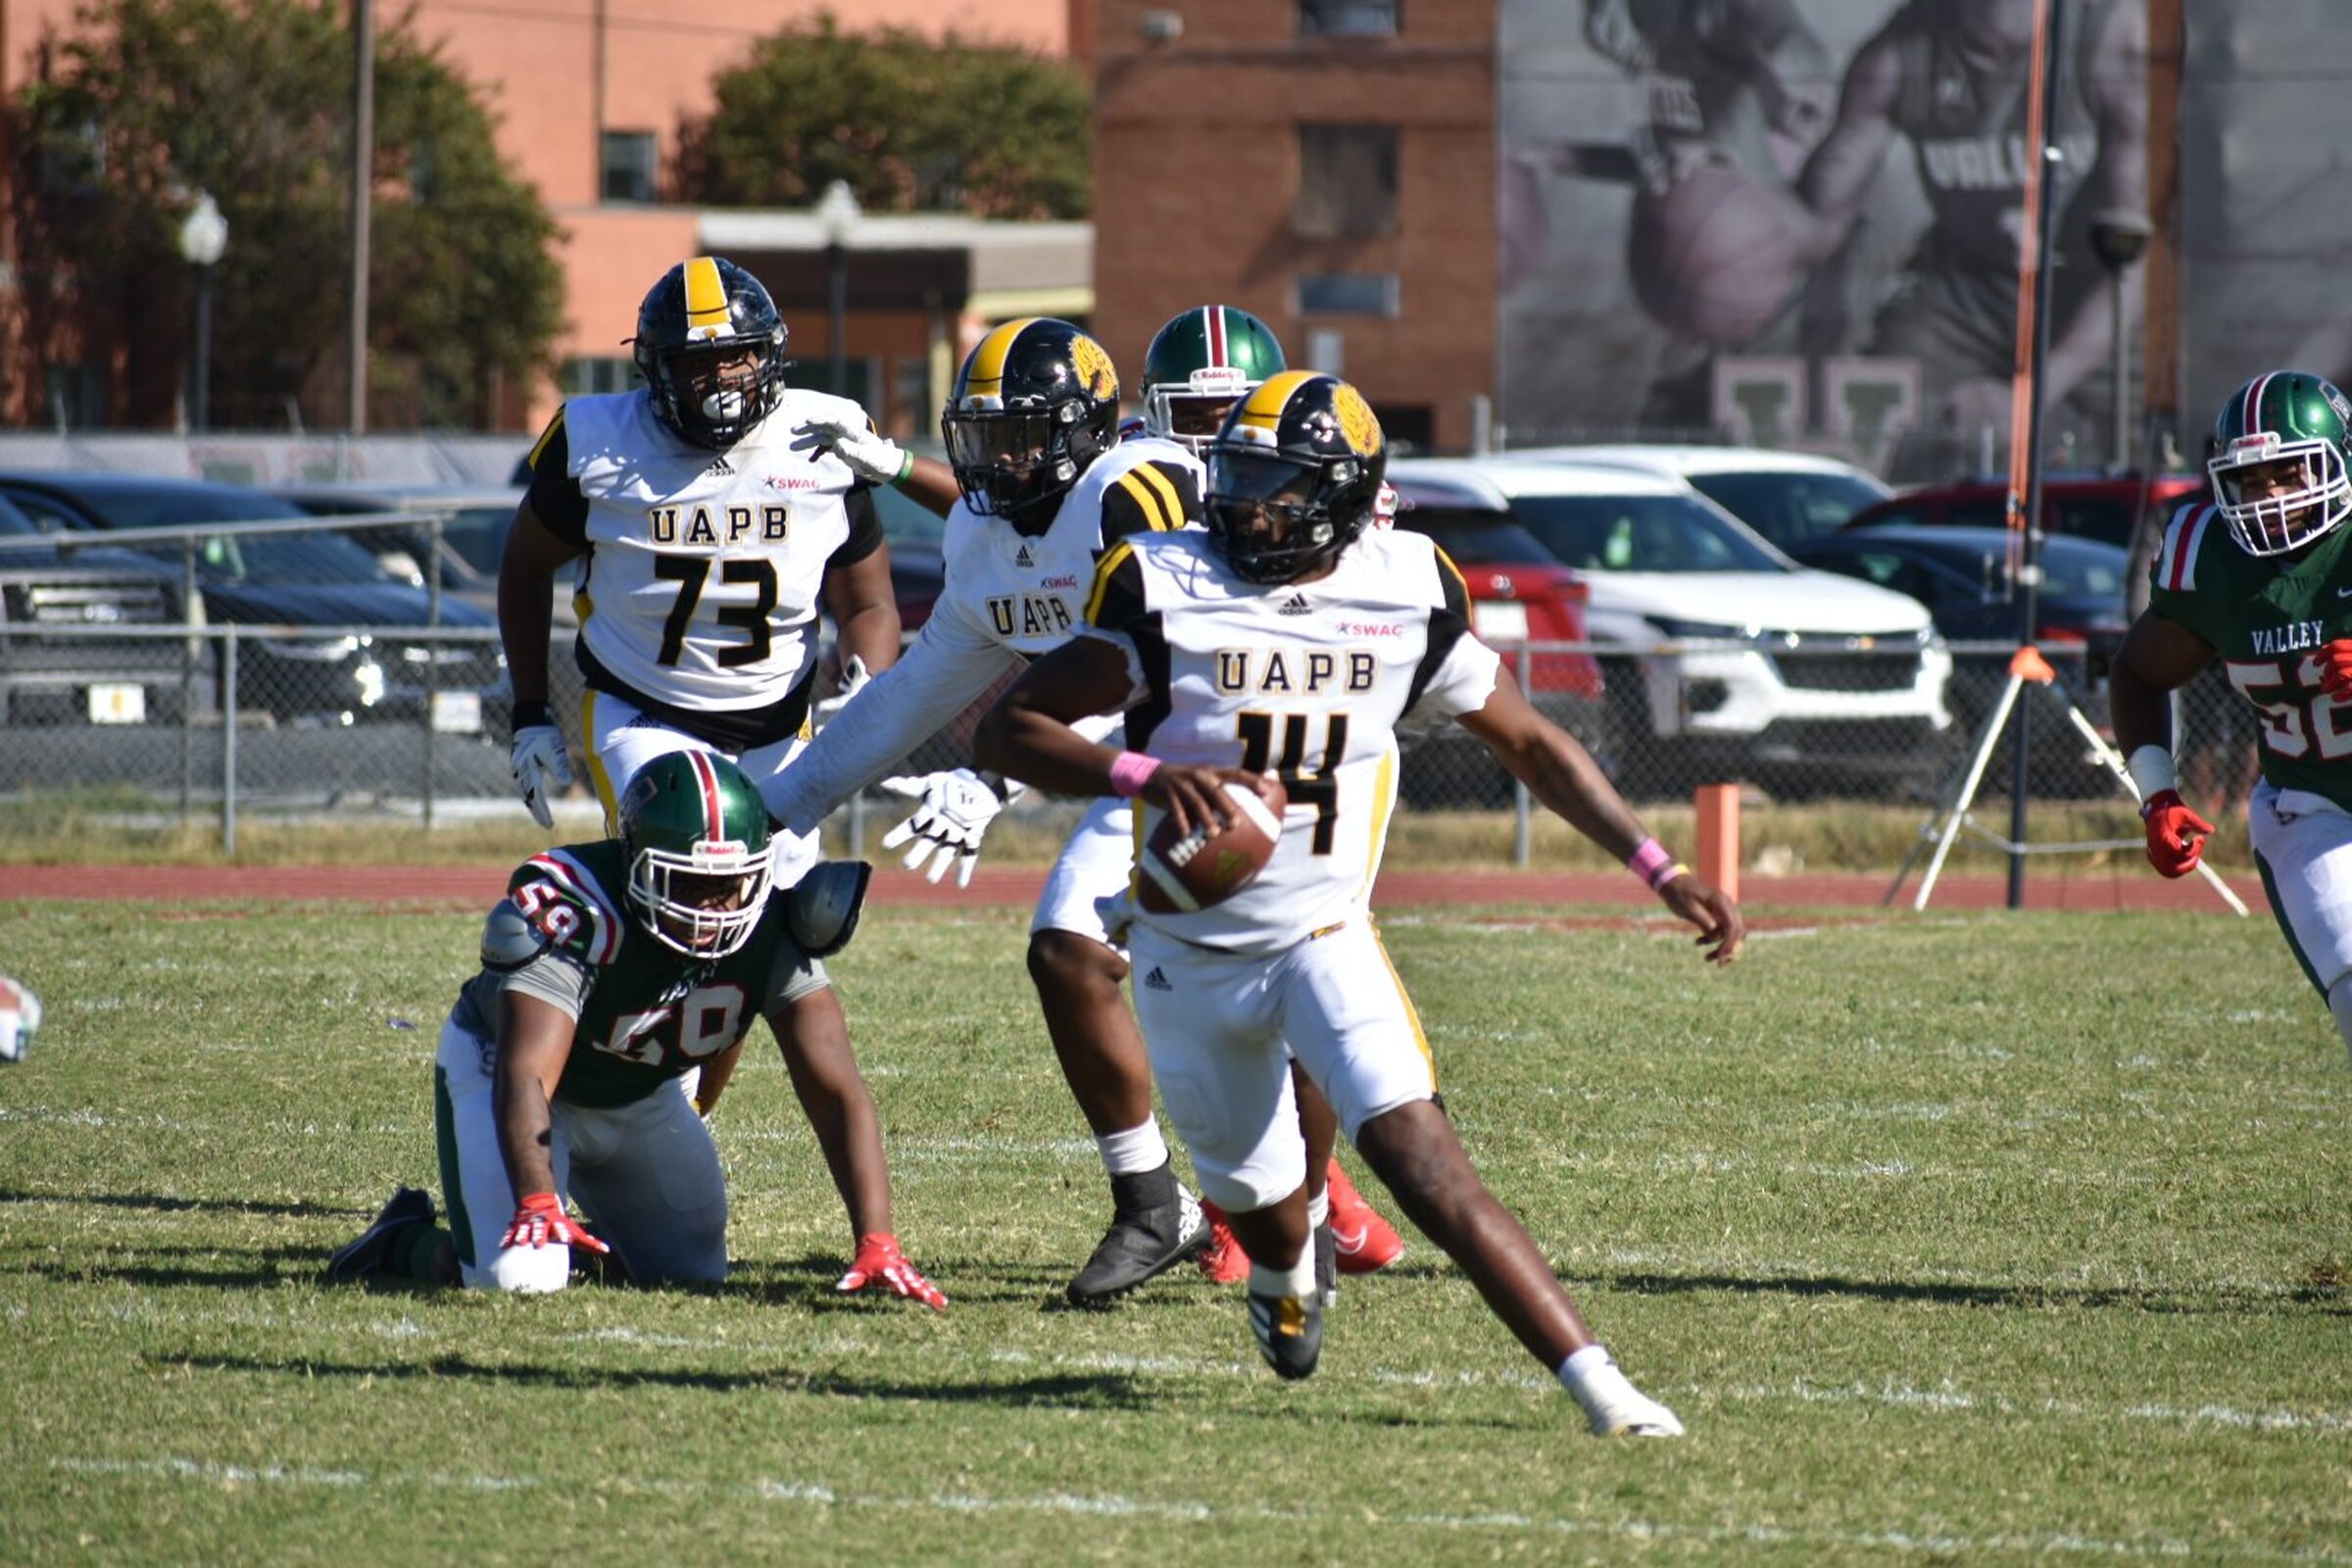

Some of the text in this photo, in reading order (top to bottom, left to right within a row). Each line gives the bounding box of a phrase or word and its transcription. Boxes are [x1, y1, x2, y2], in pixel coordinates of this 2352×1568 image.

[1923, 135, 2099, 189] VALLY
[777, 478, 821, 489] SWAC
[650, 504, 792, 547] UAPB
[654, 554, 779, 668] 73
[1351, 623, 1404, 637] SWAC
[2251, 619, 2325, 656] VALLEY
[1216, 647, 1381, 697] UAPB
[2226, 653, 2352, 760] 52
[1236, 710, 1348, 857] 14
[511, 879, 582, 946] 59
